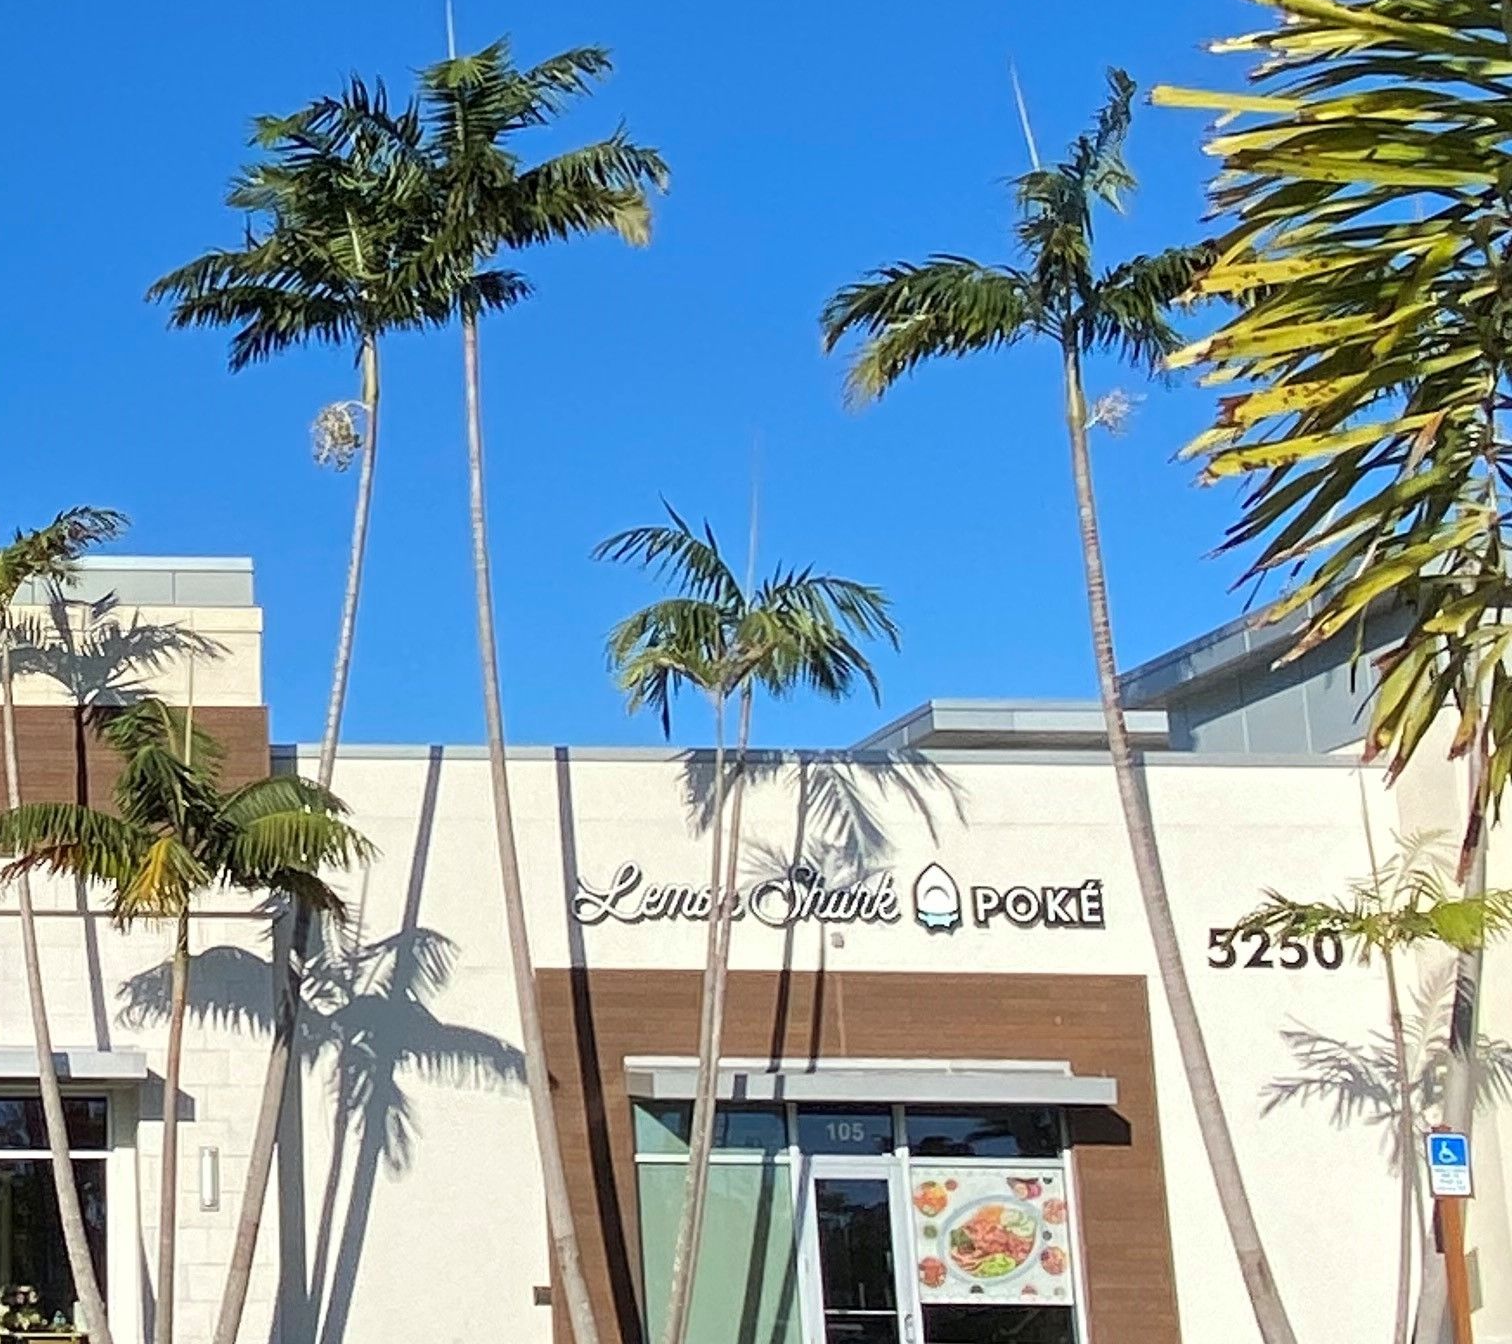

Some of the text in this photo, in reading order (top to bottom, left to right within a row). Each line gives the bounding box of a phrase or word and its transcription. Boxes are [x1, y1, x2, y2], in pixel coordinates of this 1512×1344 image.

[972, 879, 1105, 930] POKÉ
[1207, 927, 1344, 970] 5250
[826, 1122, 865, 1142] 105
